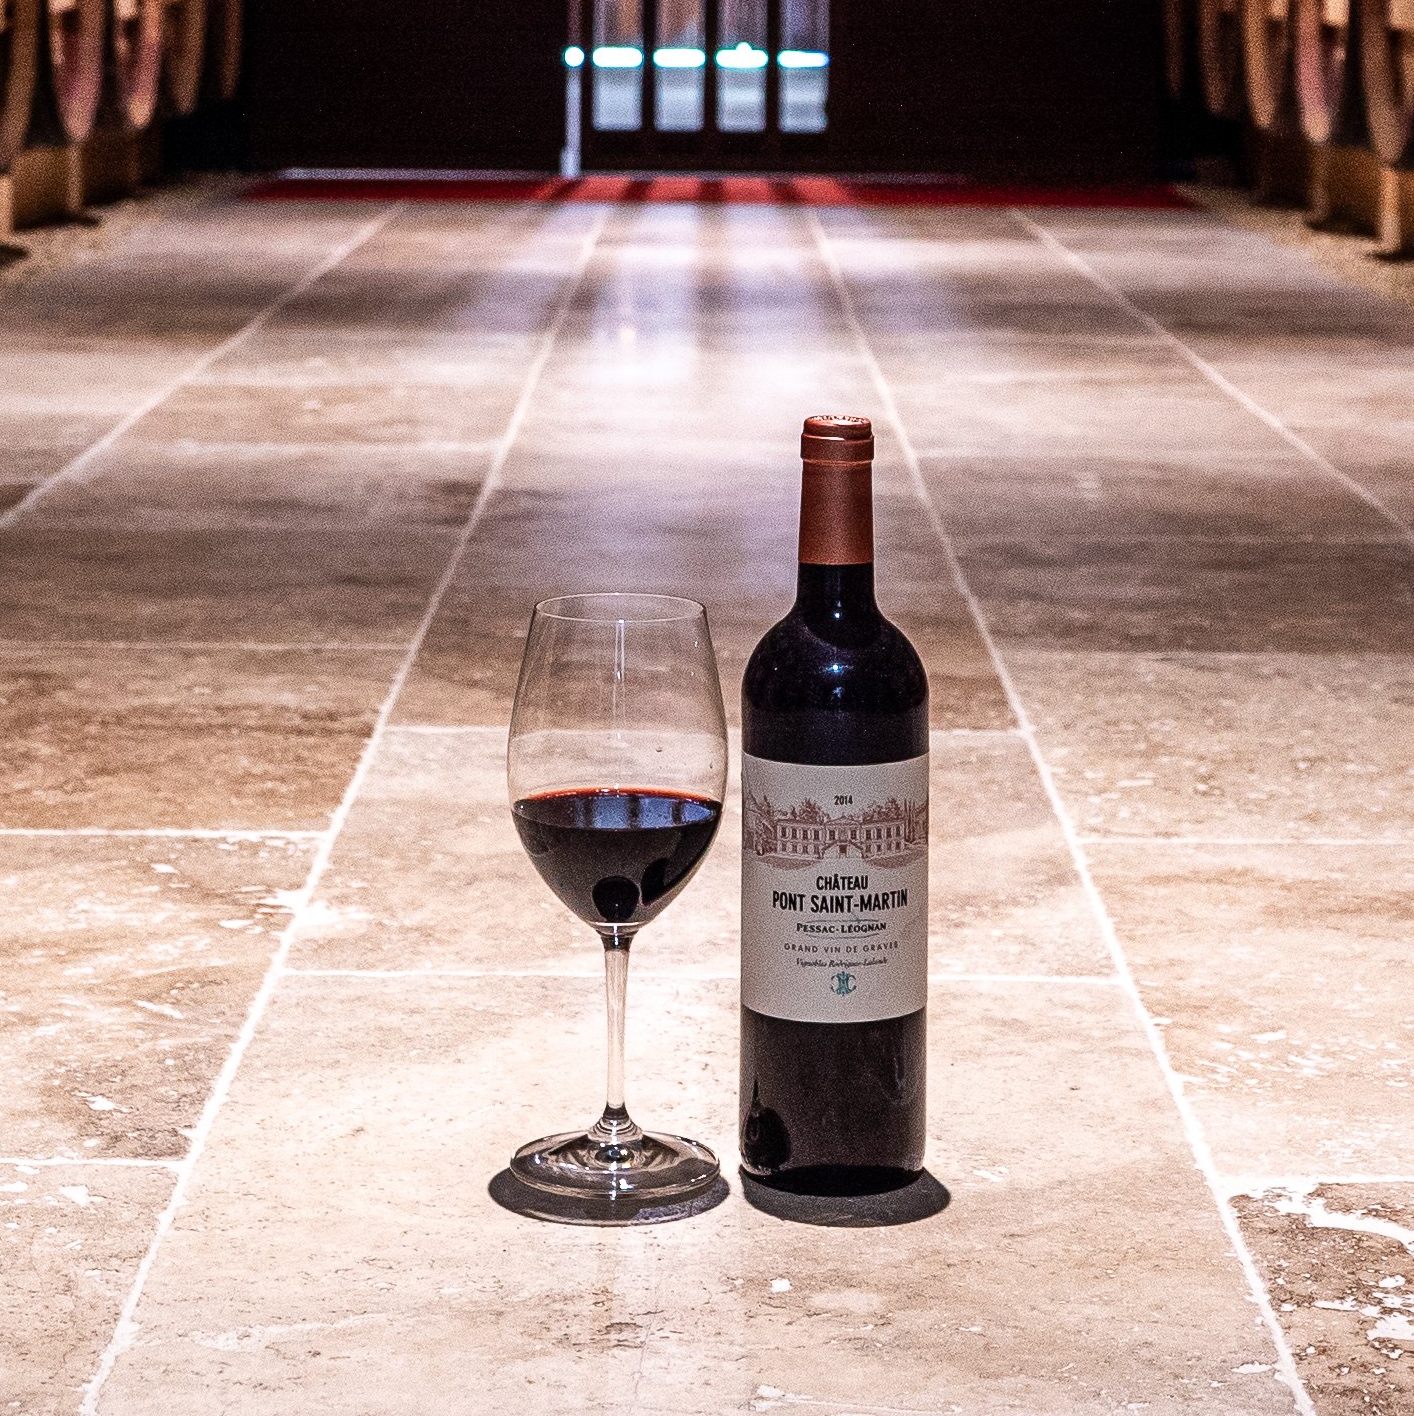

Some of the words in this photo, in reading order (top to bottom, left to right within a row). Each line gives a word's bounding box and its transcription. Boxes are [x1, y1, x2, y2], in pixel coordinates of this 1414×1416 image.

[834, 795, 853, 806] 2014
[816, 873, 869, 891] CHÂTEAU
[772, 890, 806, 912] PONT
[810, 889, 908, 914] SAINT-MARTIN
[796, 922, 887, 934] PESSAC-LÉOGNAN
[784, 943, 818, 953] GRAND
[824, 946, 841, 954] VIN
[846, 945, 858, 954] DE
[862, 940, 899, 953] GRAVES
